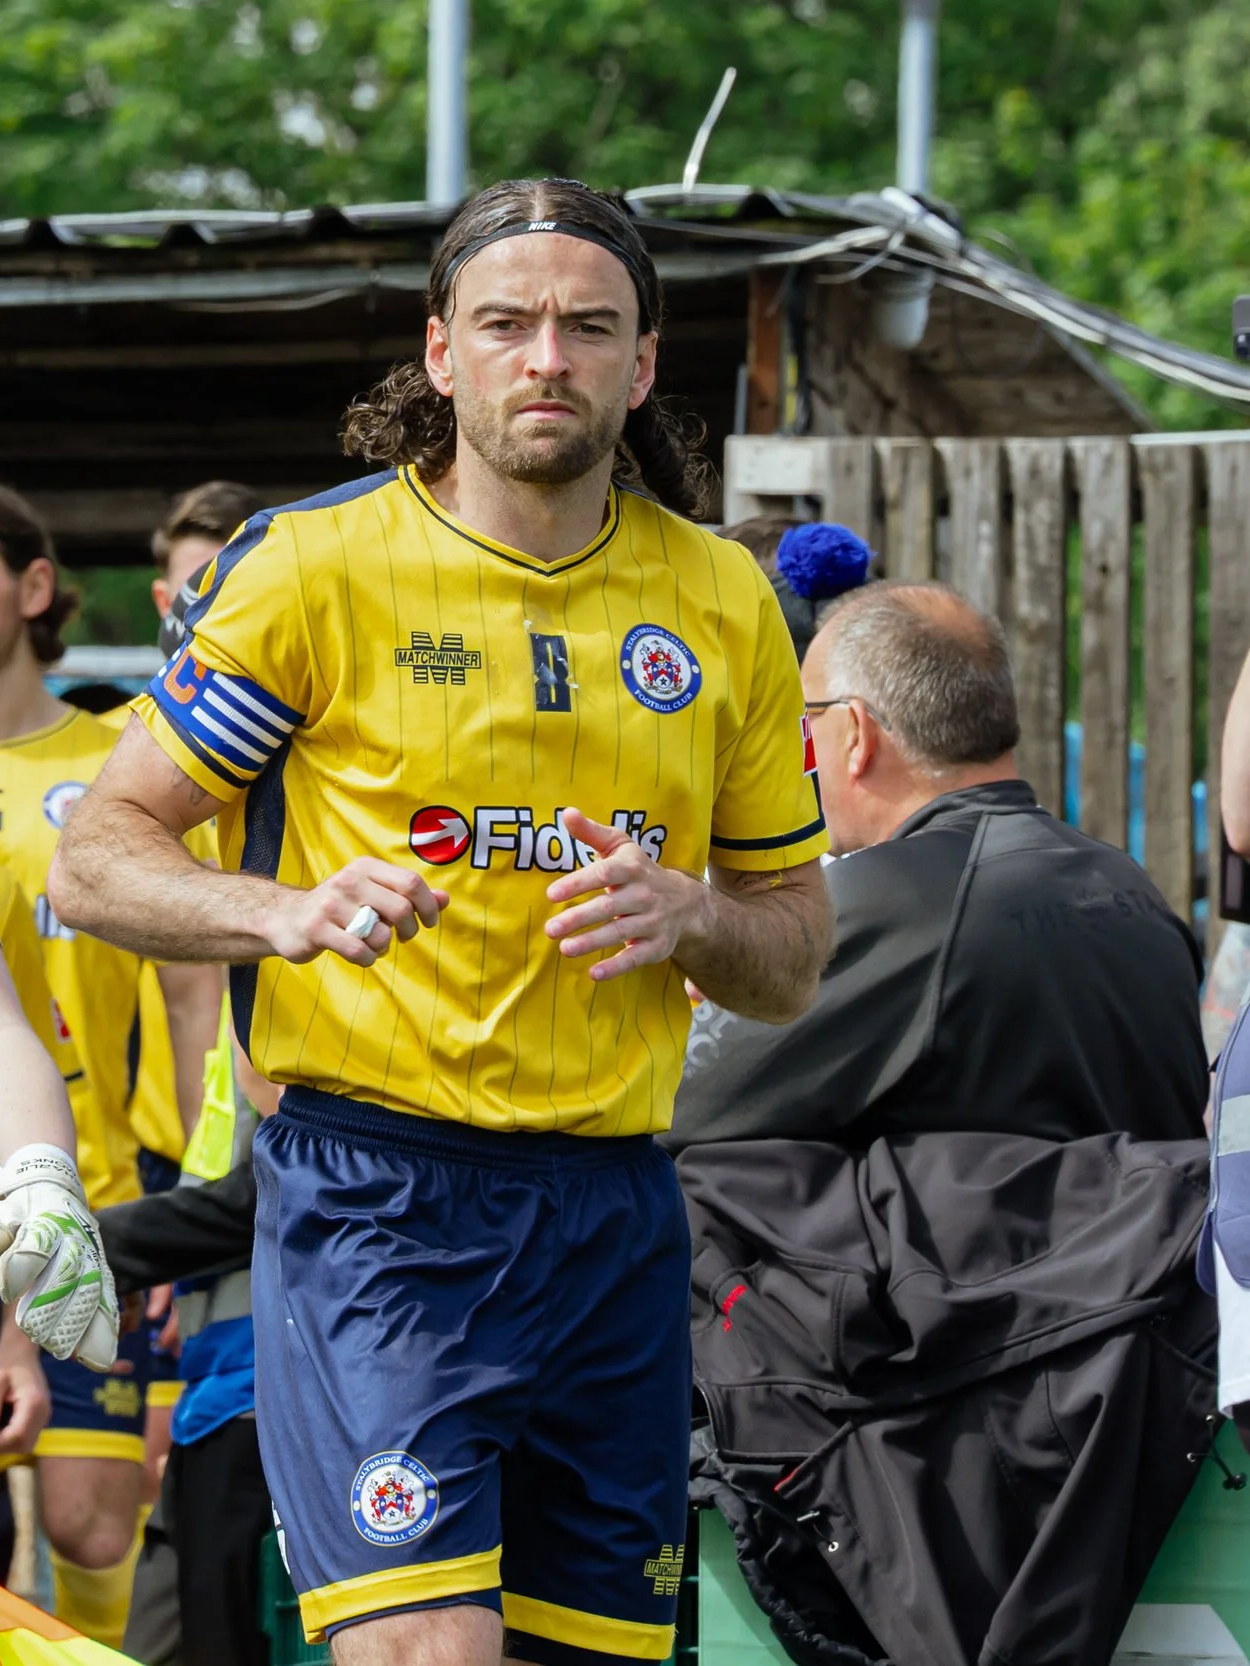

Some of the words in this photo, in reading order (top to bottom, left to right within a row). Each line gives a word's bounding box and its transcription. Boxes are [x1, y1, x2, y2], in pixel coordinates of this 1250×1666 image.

[529, 222, 557, 231] NIKE
[626, 627, 665, 652] STALYBRIDGE
[665, 633, 691, 657] CELTIC
[397, 650, 480, 667] MATCHWINNER
[163, 645, 207, 705] C
[529, 633, 572, 712] 8
[634, 689, 673, 711] FOOTBALL
[672, 692, 693, 709] CLUB
[355, 1456, 403, 1491] STALYBRIDGE
[403, 1459, 430, 1482] CELTIC
[363, 1526, 408, 1542] FOOTBALL
[407, 1518, 429, 1536] CLUB
